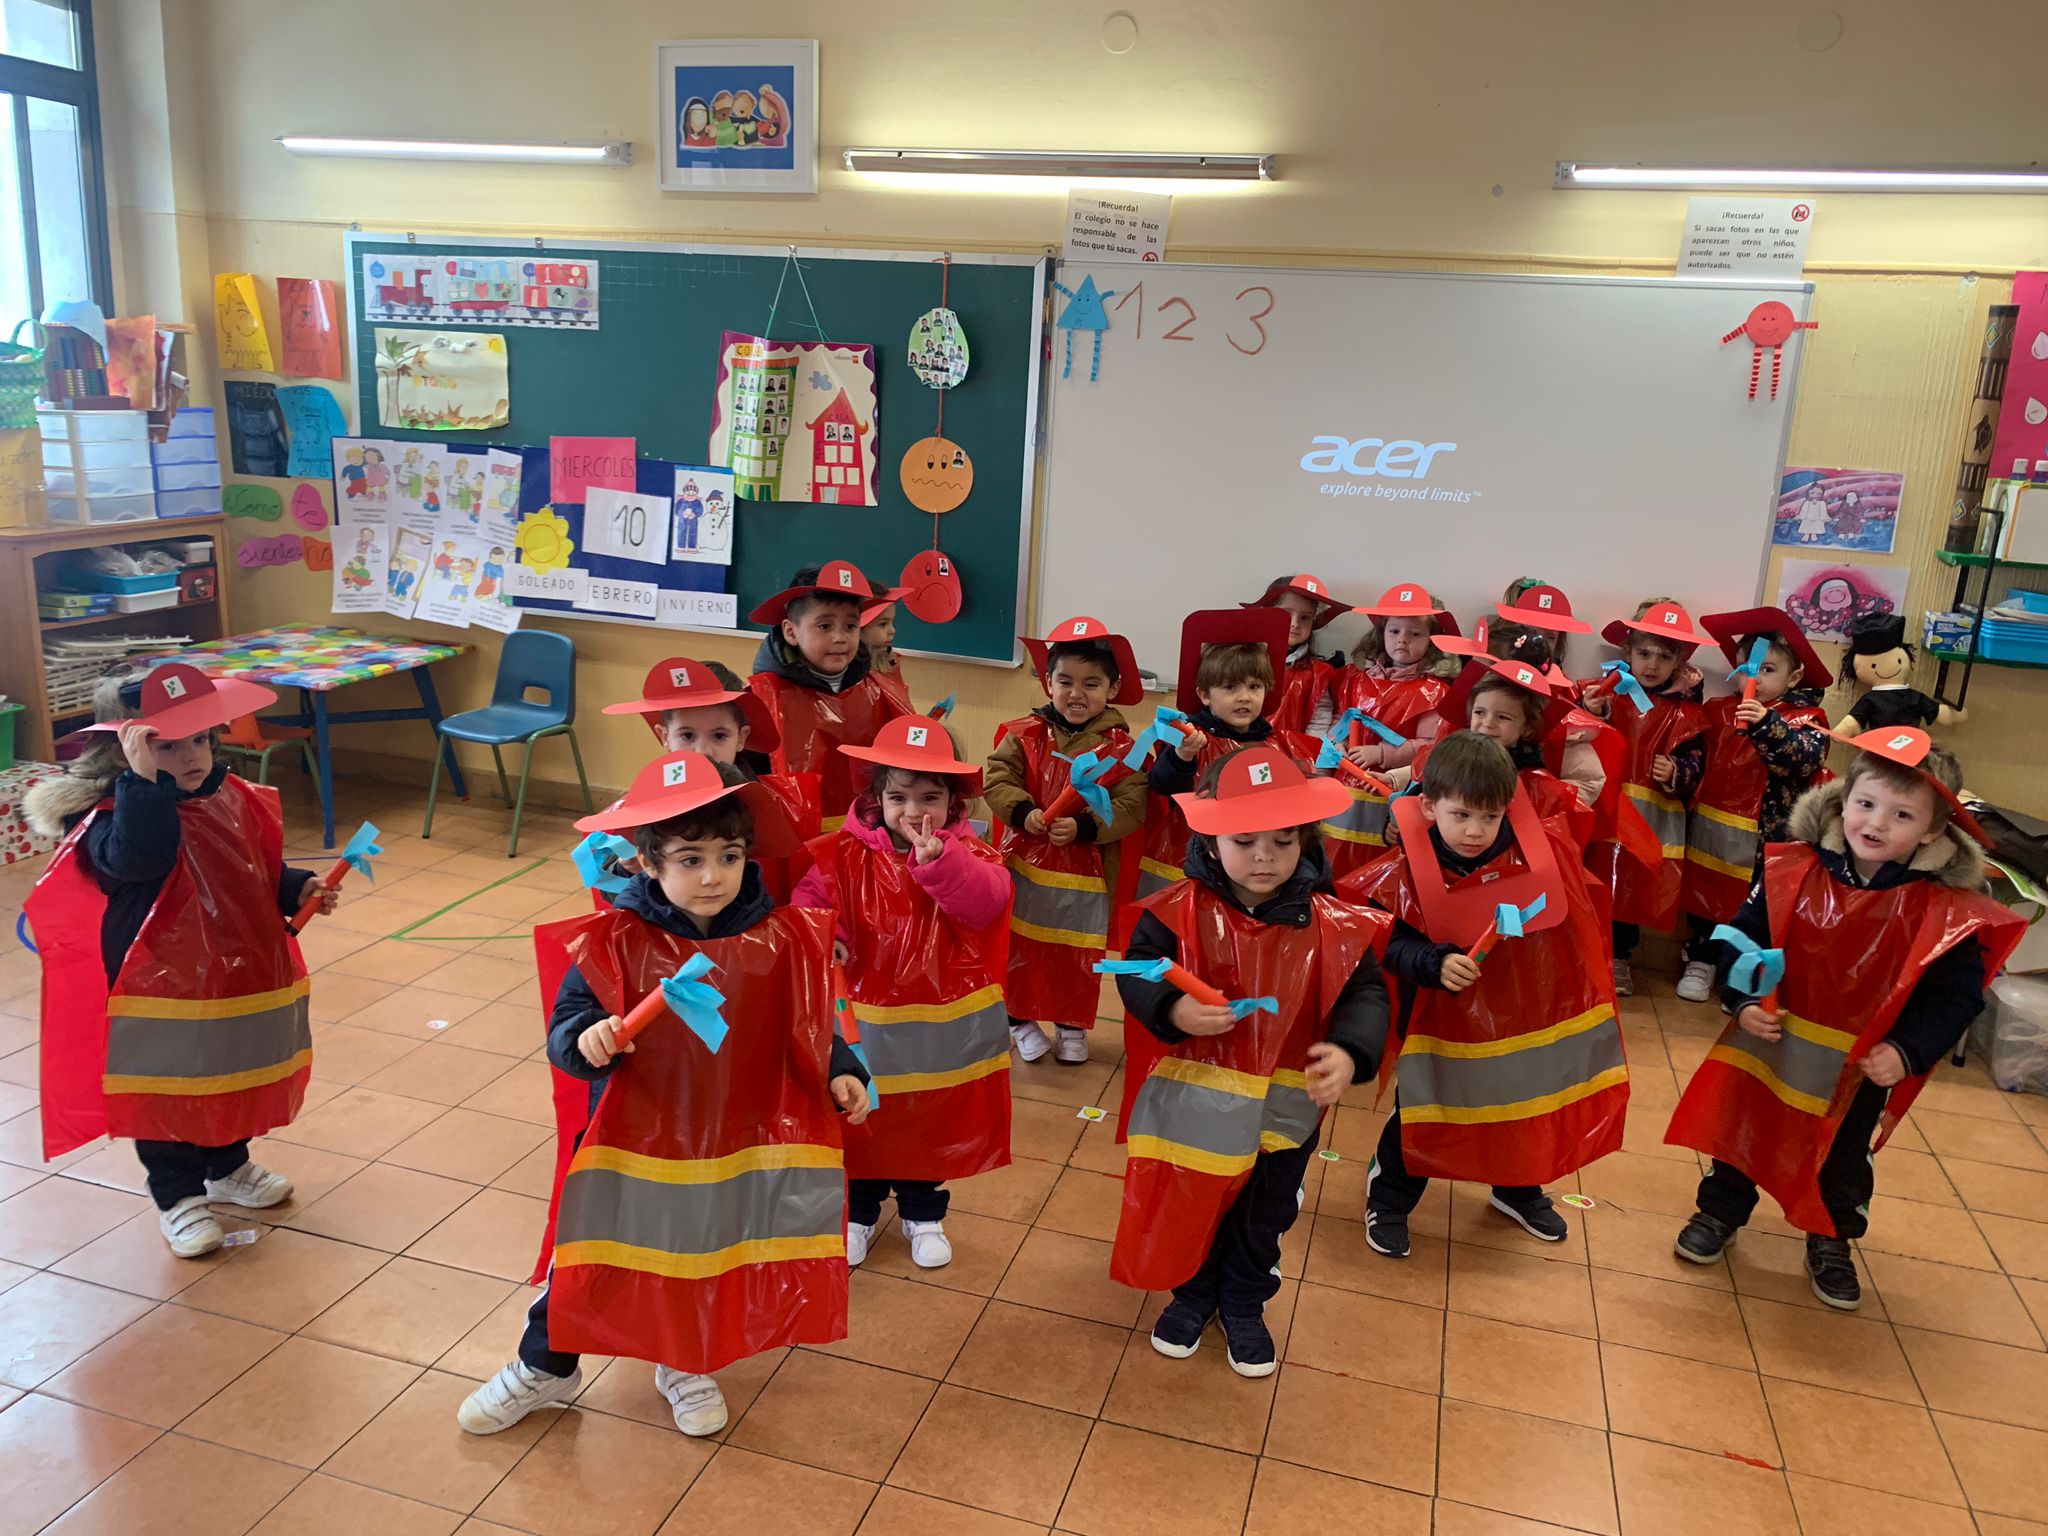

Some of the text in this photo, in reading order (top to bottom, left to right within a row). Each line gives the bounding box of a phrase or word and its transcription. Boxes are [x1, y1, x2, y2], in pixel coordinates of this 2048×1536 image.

[1098, 201, 1138, 212] ¡Recuerda!
[1074, 212, 1159, 230] El colegio no se hace
[1722, 212, 1764, 220] ¡Recuerda!
[1072, 226, 1157, 244] responsable de las
[1694, 224, 1702, 232] Si
[1730, 225, 1750, 234] fotos
[1769, 226, 1780, 234] las
[1784, 228, 1800, 237] que
[1072, 238, 1090, 248] fotos
[1091, 242, 1106, 251] que
[1116, 246, 1138, 254] sacas.
[1692, 238, 1730, 247] aparezcan
[1742, 238, 1762, 246] otros
[1689, 248, 1713, 258] puede
[1719, 250, 1730, 258] ser
[1736, 251, 1750, 260] que
[1773, 251, 1794, 260] estén
[1688, 262, 1733, 270] autorizados.
[1115, 281, 1276, 355] 1 2 3
[1300, 435, 1457, 479] acer
[554, 456, 635, 479] MIERCOLES
[1320, 482, 1371, 498] explore
[1375, 484, 1429, 502] beyond
[294, 490, 323, 526] te
[614, 504, 646, 546] 10
[518, 576, 574, 590] SOLEADO
[592, 586, 652, 604] EBRERO
[662, 596, 732, 614] INVIERNO
